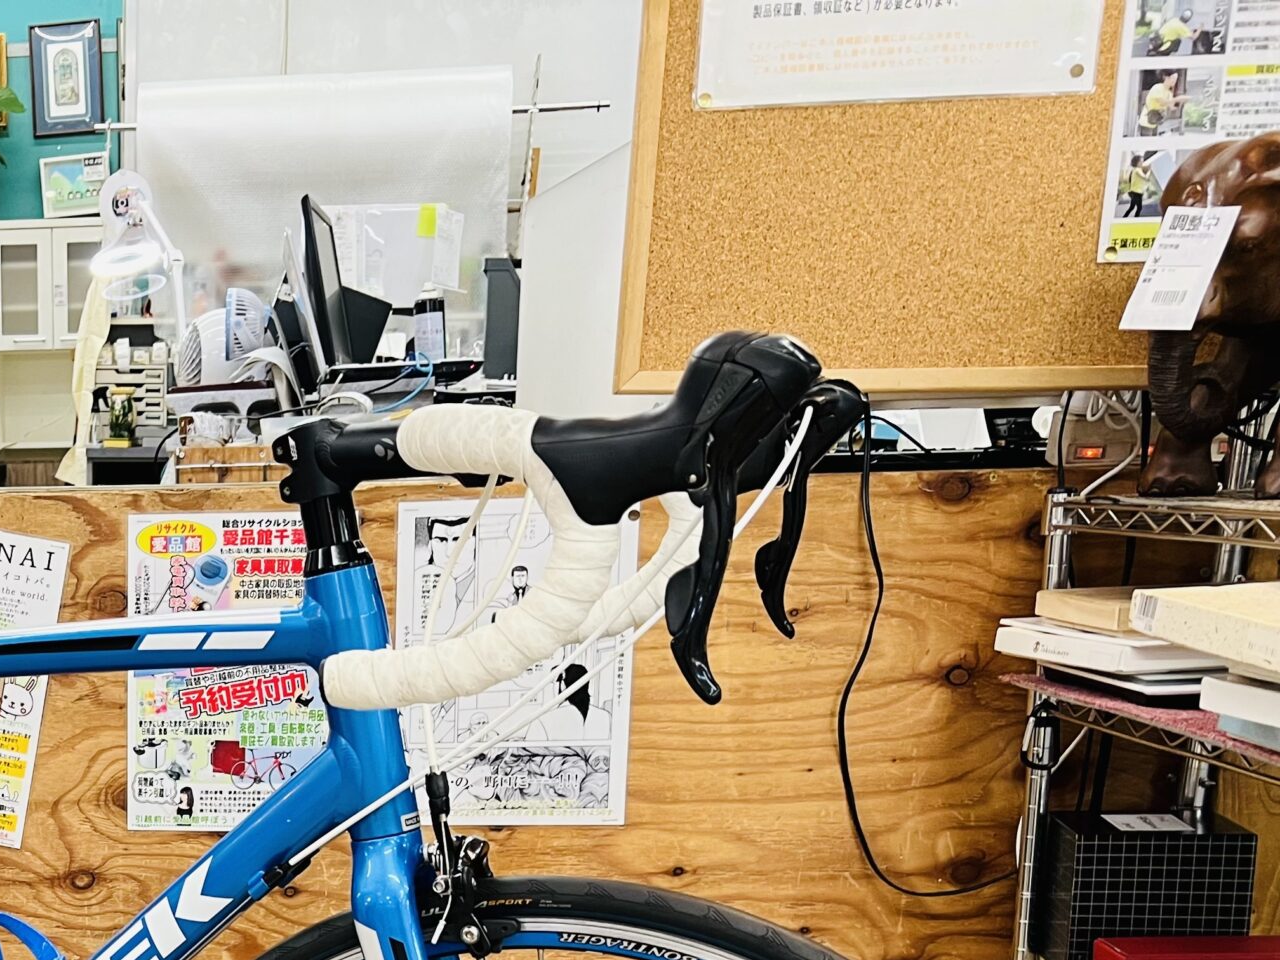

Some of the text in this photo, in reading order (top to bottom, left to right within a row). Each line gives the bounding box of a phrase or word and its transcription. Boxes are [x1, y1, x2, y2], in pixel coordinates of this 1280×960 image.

[1169, 214, 1220, 231] 調整中
[156, 523, 197, 534] リサイクル
[223, 528, 307, 546] 愛品館千葉
[151, 536, 202, 553] 愛品館
[1, 585, 17, 596] the
[180, 670, 308, 718] 予約受付中
[487, 898, 532, 907] SPORT
